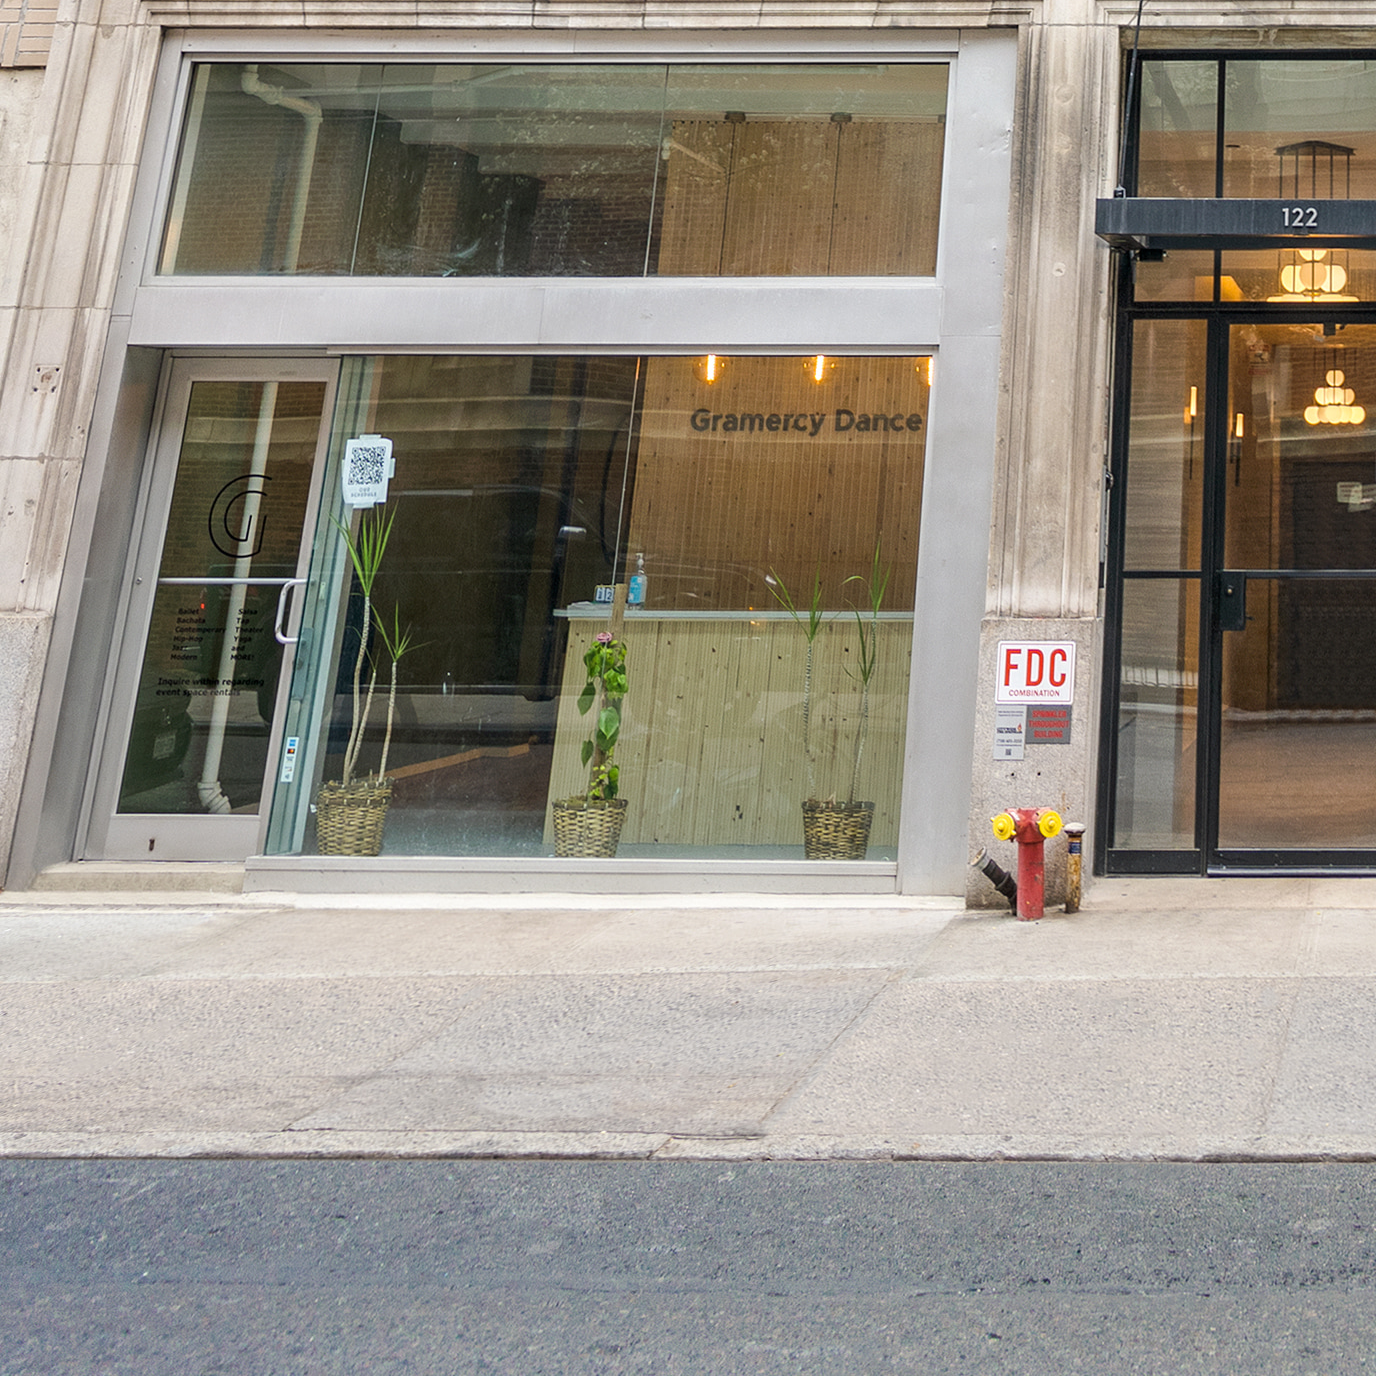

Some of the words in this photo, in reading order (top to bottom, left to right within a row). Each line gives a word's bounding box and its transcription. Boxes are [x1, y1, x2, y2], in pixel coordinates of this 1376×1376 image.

[1281, 207, 1318, 227] 122
[690, 408, 826, 436] Gramercy
[834, 409, 922, 432] Dance
[1004, 648, 1067, 687] FDC
[158, 677, 190, 687] Inquire
[192, 677, 219, 686] within
[222, 677, 265, 687] regarding
[1008, 689, 1060, 697] COMBINATION
